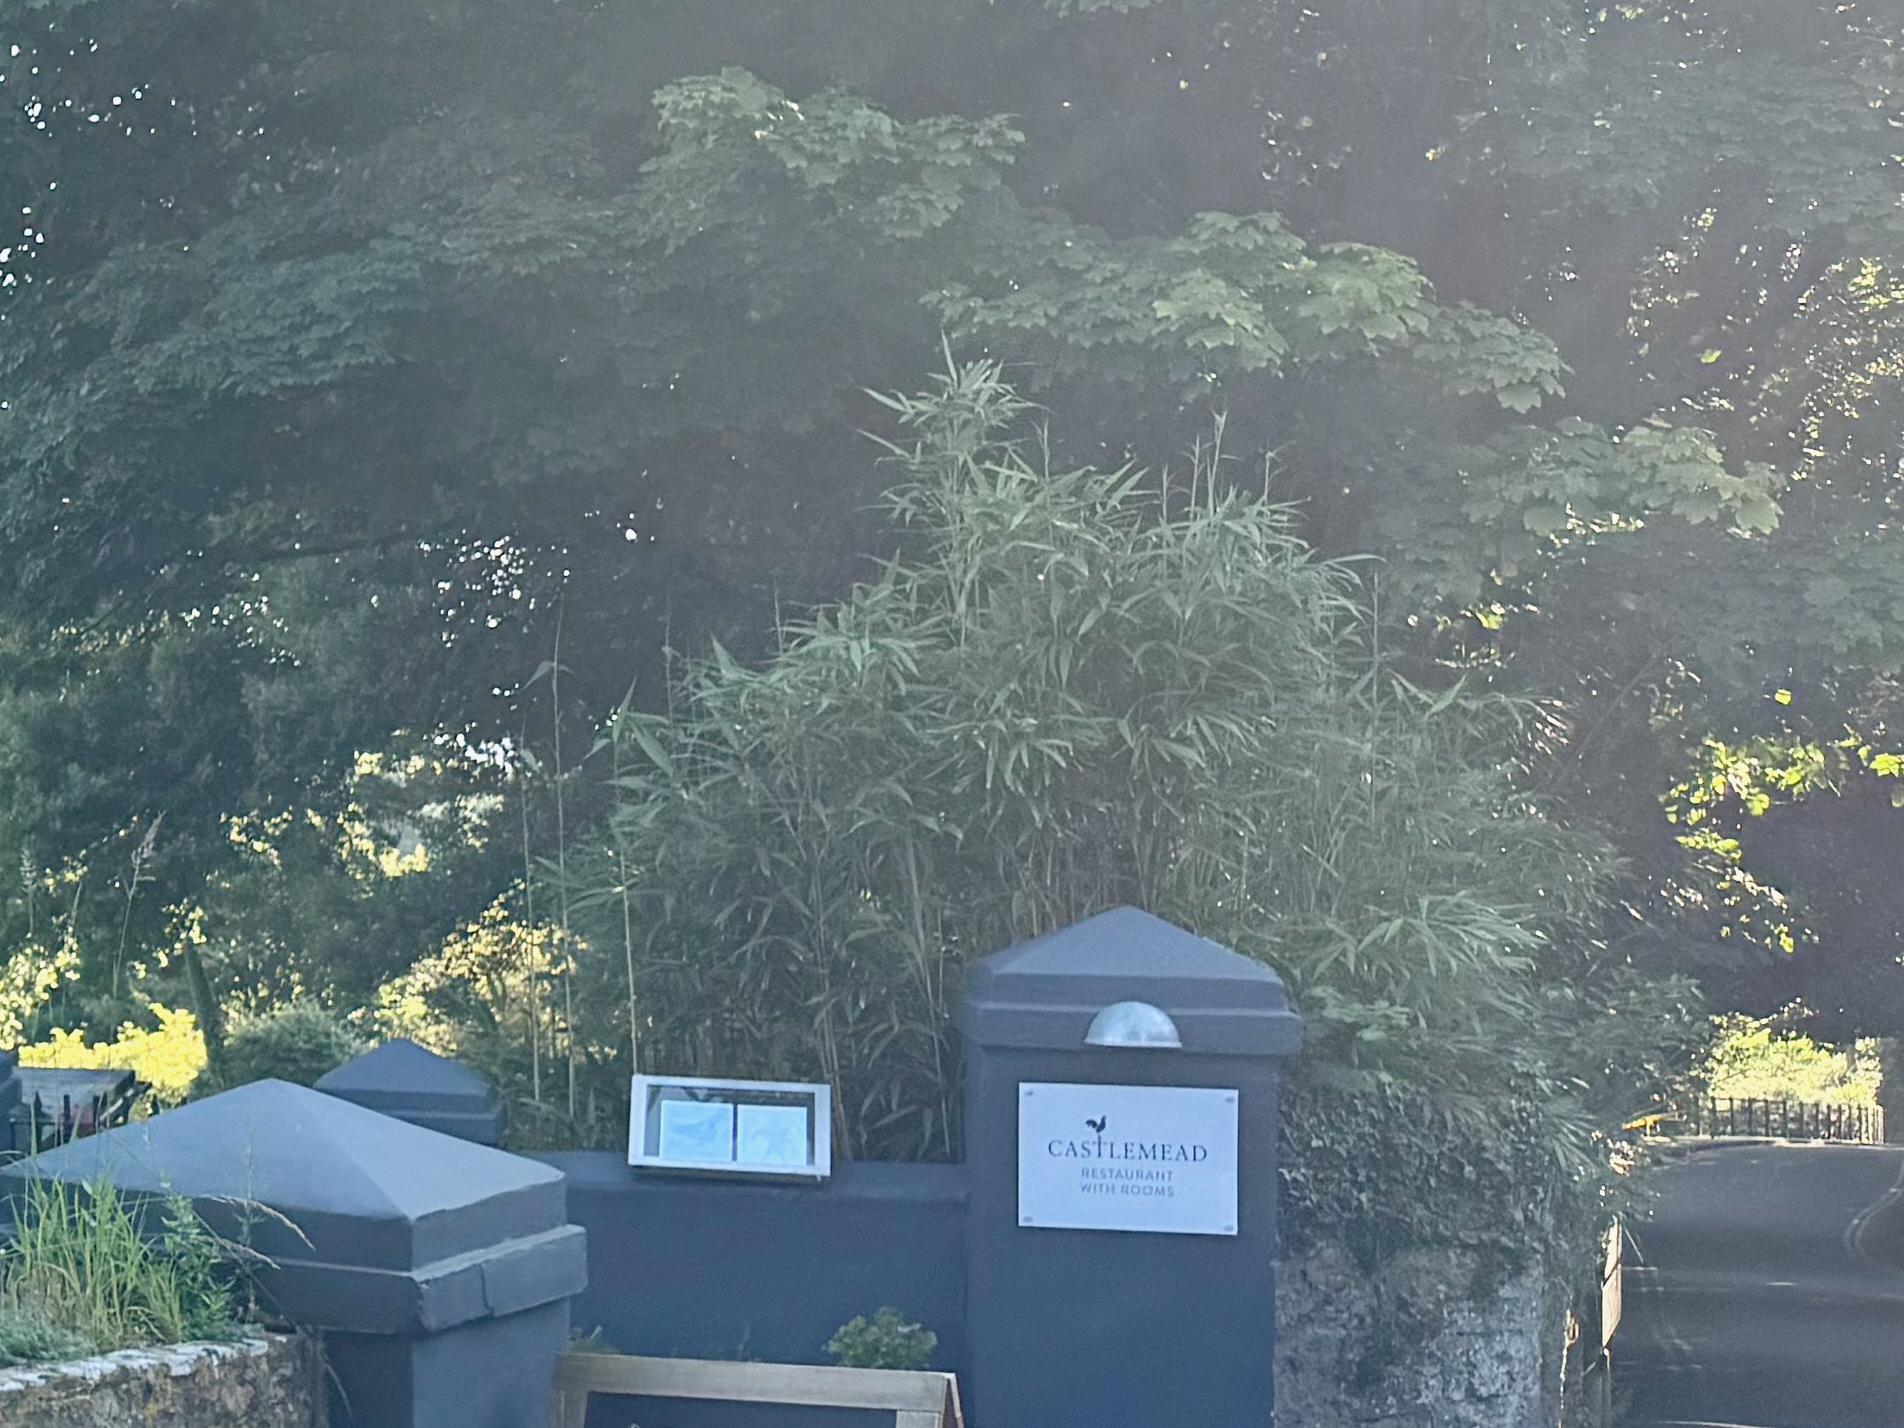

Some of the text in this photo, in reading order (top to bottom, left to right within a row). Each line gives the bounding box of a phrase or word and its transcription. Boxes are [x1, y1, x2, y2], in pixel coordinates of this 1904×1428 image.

[1048, 1136, 1208, 1163] CASTLEMEAD
[1081, 1167, 1173, 1182] RESTAURANT
[1081, 1183, 1175, 1198] WITH ROOMS
